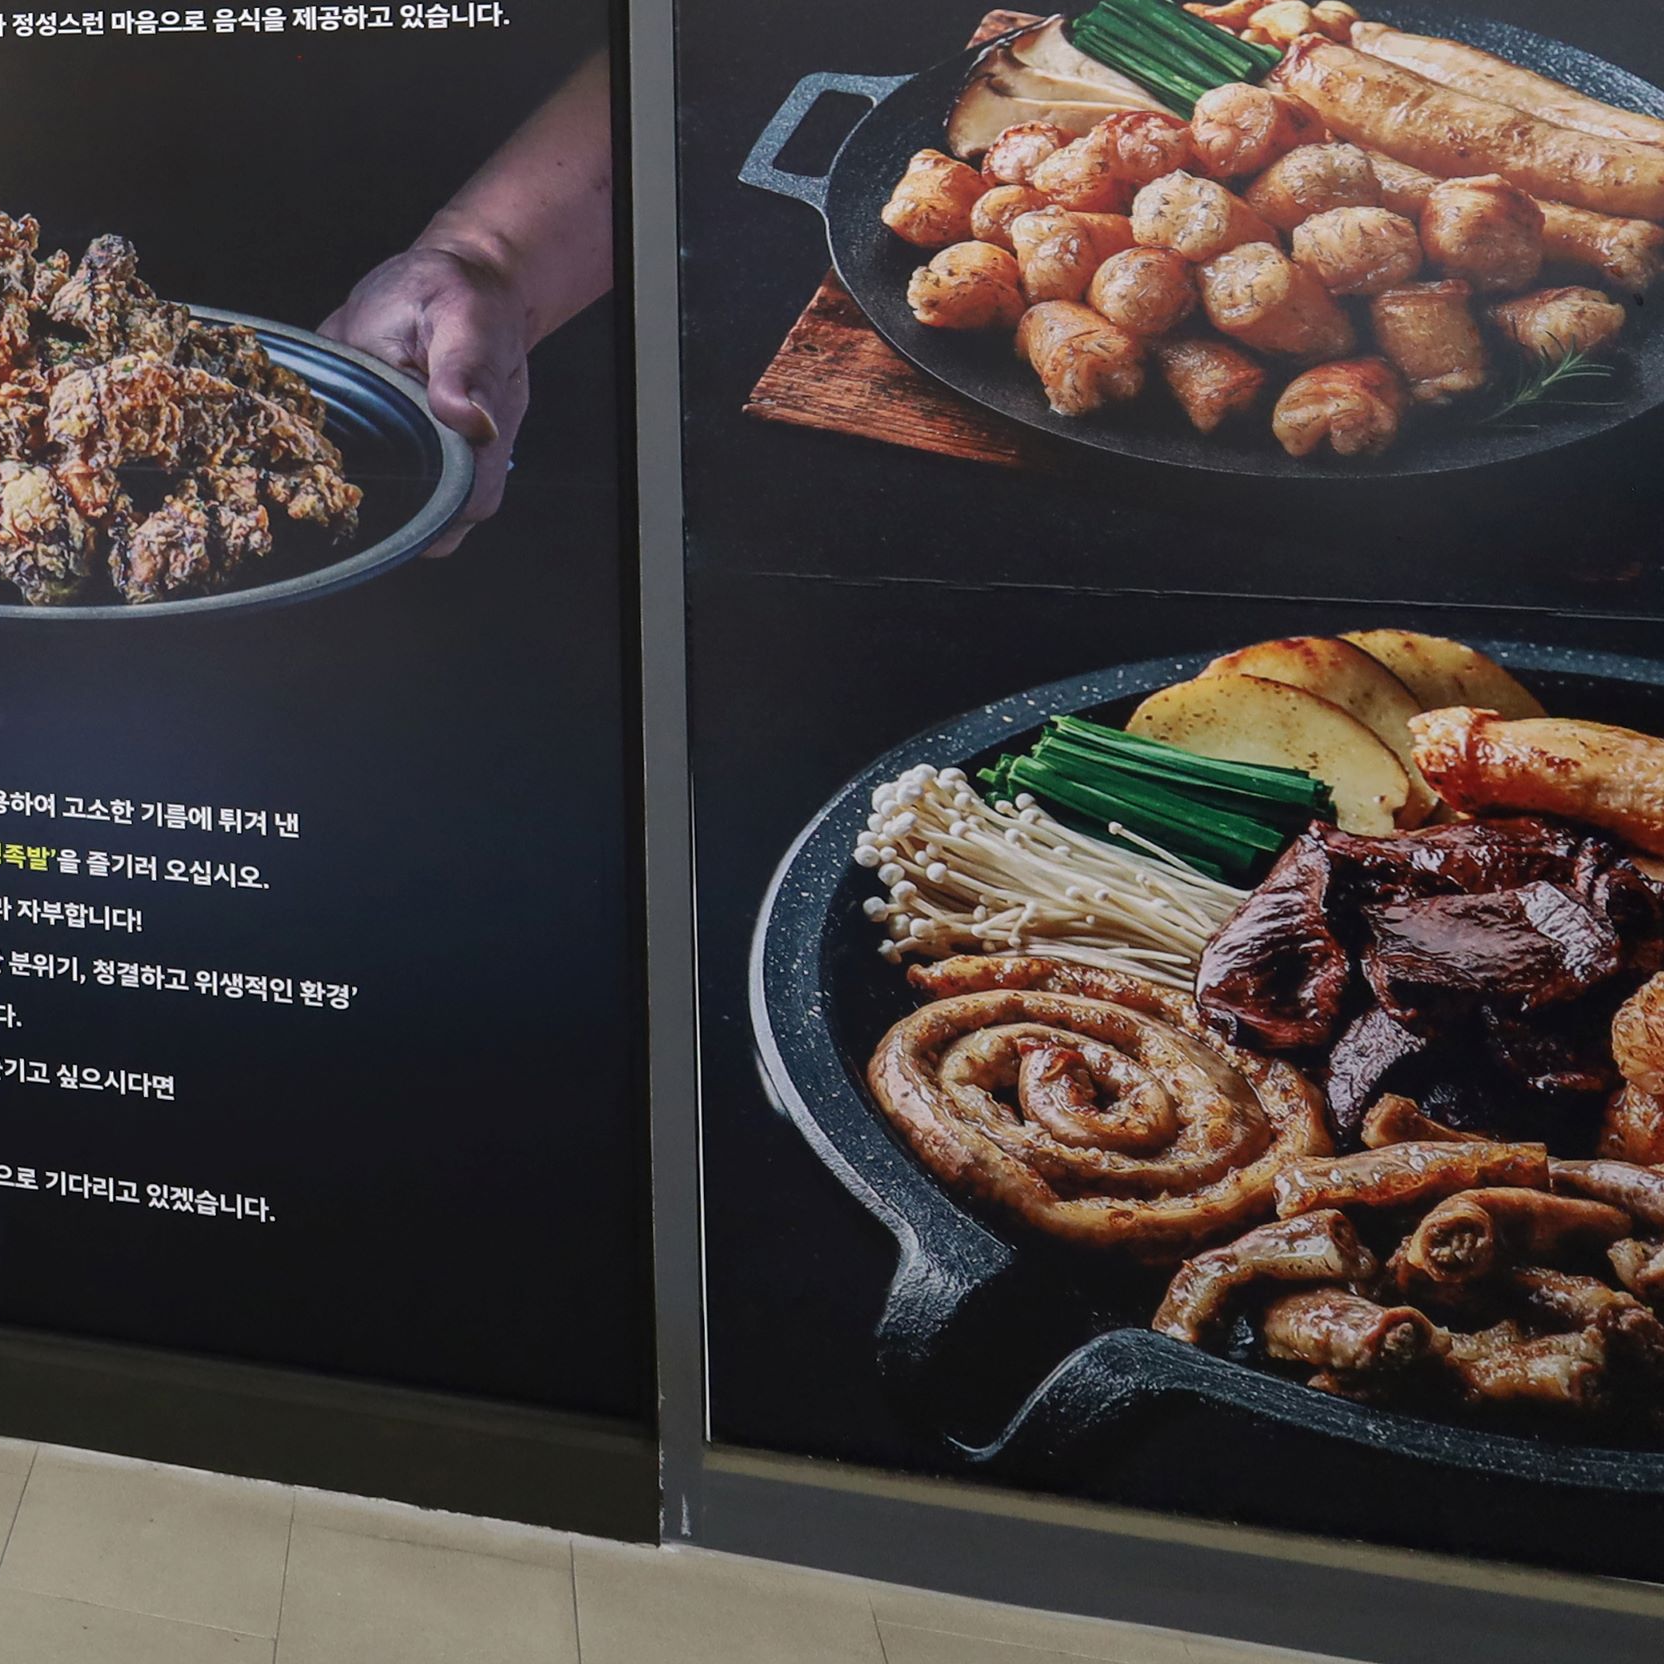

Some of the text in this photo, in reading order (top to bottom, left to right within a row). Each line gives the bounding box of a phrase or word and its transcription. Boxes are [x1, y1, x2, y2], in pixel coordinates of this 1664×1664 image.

[11, 10, 105, 38] 정성스런
[110, 9, 208, 35] 마음으로
[211, 6, 288, 34] 음식을
[291, 4, 394, 32] 제공하고
[399, 1, 511, 30] 있습니다.
[61, 796, 136, 825] 고소한
[140, 801, 213, 832] 기름에
[217, 807, 267, 837] 튀겨
[274, 812, 300, 839] 낸
[85, 850, 158, 882] 즐기러
[163, 859, 270, 890] 오십시오.
[16, 898, 143, 934] 자부합니다!
[7, 950, 87, 985] 분위기,
[92, 958, 190, 991] 청결하고
[193, 969, 294, 1005] 위생적인
[55, 1063, 175, 1101] 싶으시다면
[44, 1170, 141, 1204] 기다리고
[145, 1183, 276, 1223] 있겠습니다.
